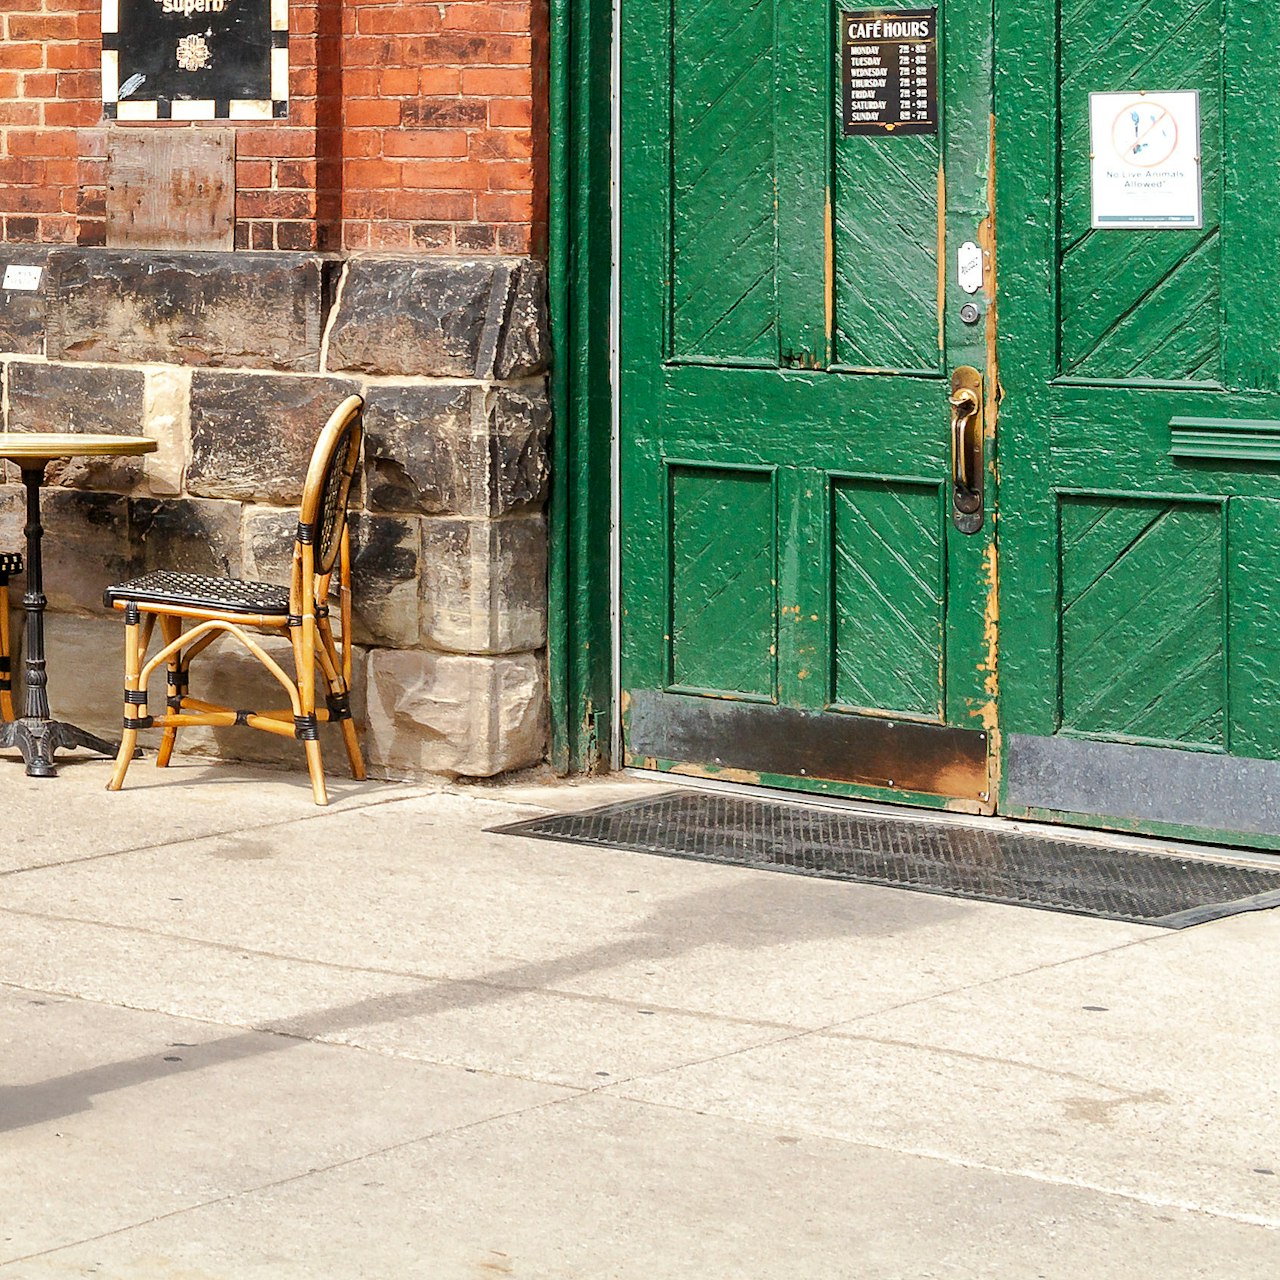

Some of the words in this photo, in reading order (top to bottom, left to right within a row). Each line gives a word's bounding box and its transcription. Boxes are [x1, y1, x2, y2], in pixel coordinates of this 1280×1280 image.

[848, 20, 881, 39] CAFÉ
[883, 21, 929, 38] HOURS
[850, 46, 879, 55] MONDAY
[851, 57, 881, 66] TUESDAY
[850, 67, 888, 77] WEDNESDAY
[851, 79, 886, 88] THURSDAY
[851, 90, 876, 99] FRIDAY
[851, 100, 887, 110] SATURDAY
[851, 112, 879, 121] SUNDAY
[1146, 170, 1184, 178] Animals
